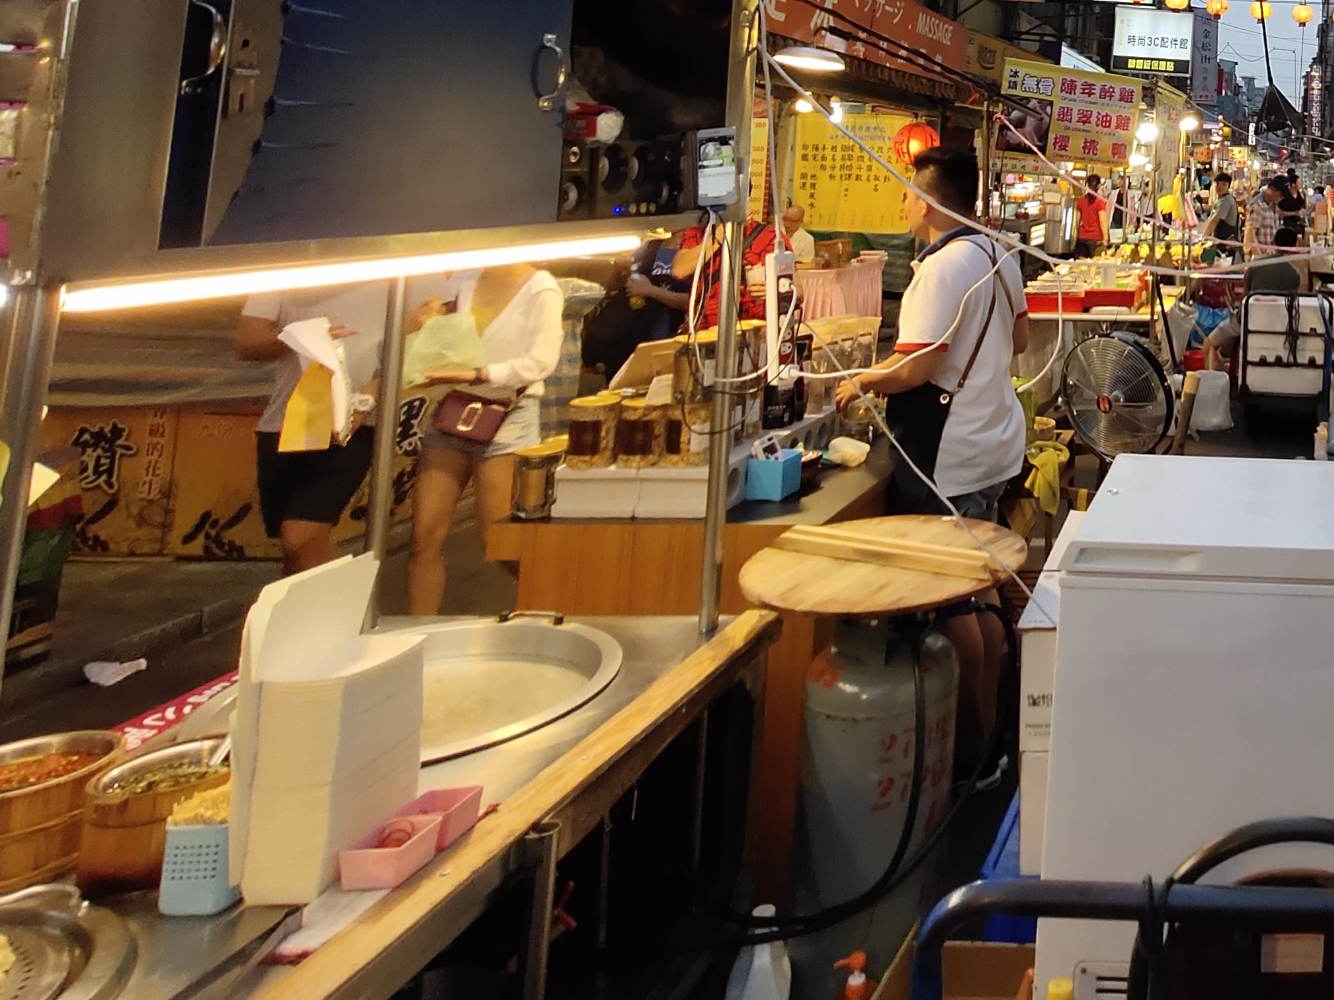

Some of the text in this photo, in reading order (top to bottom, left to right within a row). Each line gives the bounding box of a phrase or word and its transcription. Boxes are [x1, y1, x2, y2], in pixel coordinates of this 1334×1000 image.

[915, 11, 954, 46] MASSAGE
[1060, 77, 1136, 105] 陳年醉雞
[1056, 105, 1132, 132] 翡翠油雞
